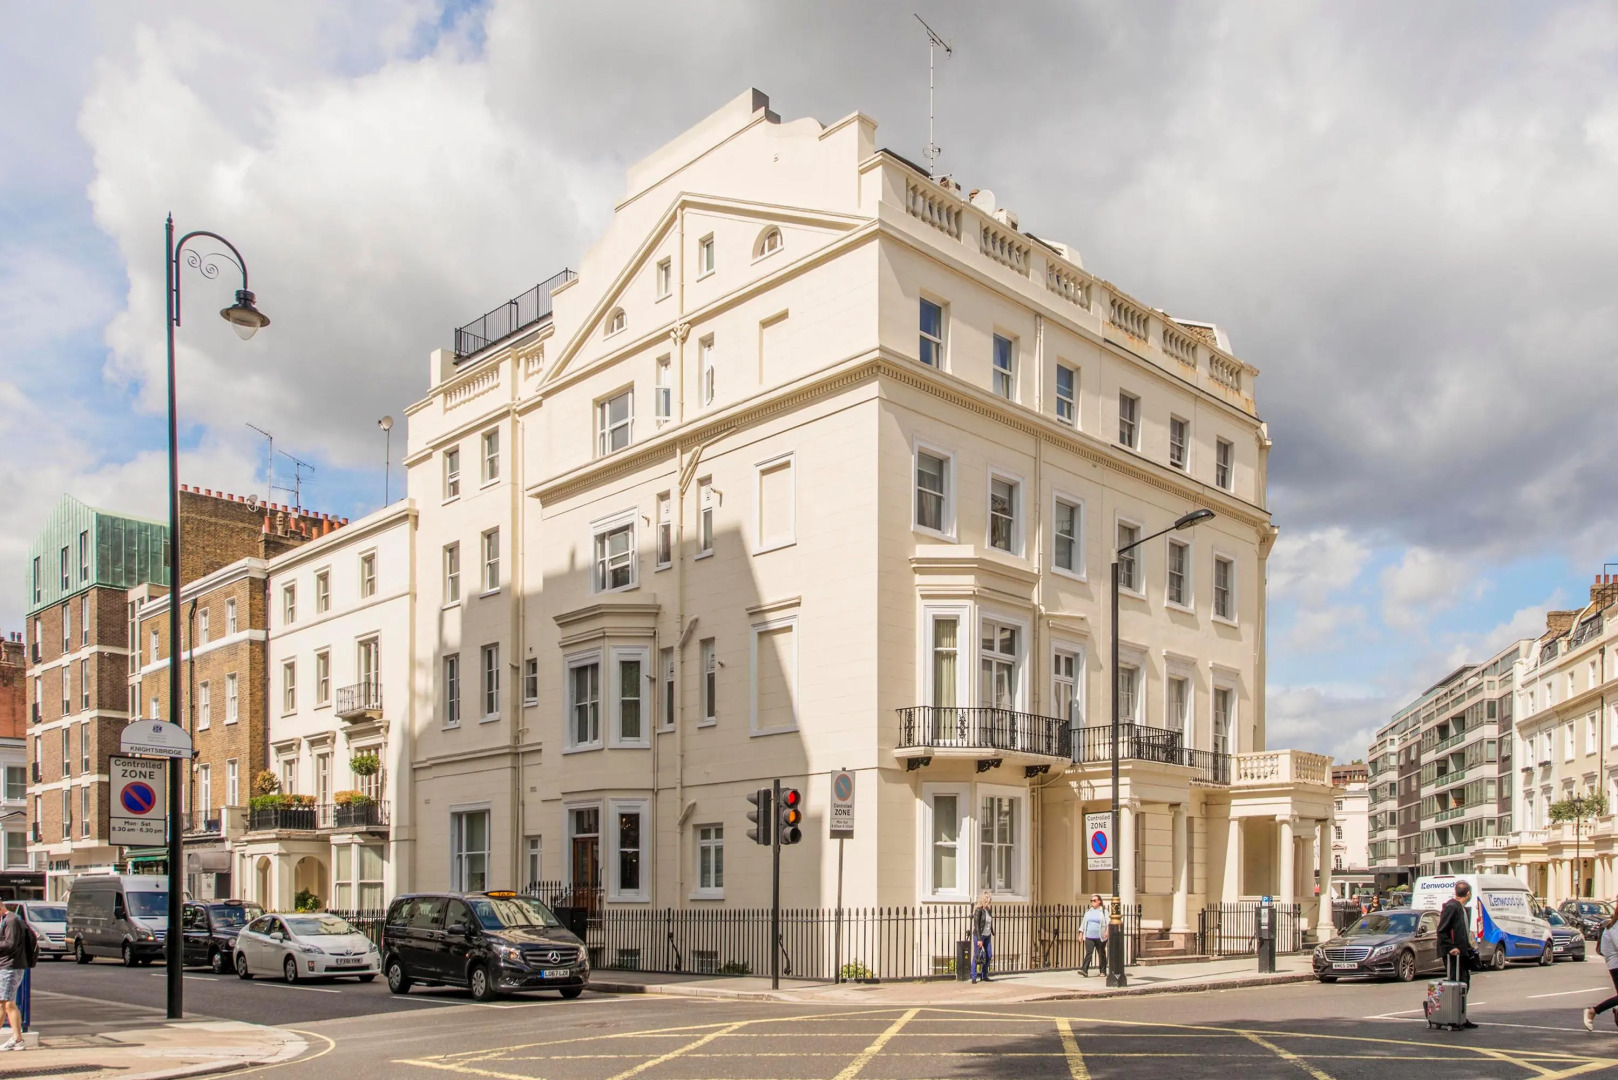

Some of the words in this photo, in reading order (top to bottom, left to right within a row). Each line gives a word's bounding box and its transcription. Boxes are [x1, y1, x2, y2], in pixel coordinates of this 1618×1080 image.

[130, 745, 183, 755] KNIGHTSBRIDGE
[114, 758, 162, 770] Controlled
[121, 769, 155, 780] ZONE
[834, 808, 851, 816] ZONE
[1090, 821, 1107, 829] ZONE
[1420, 882, 1455, 890] Kenwood
[1488, 893, 1515, 907] Kenwood
